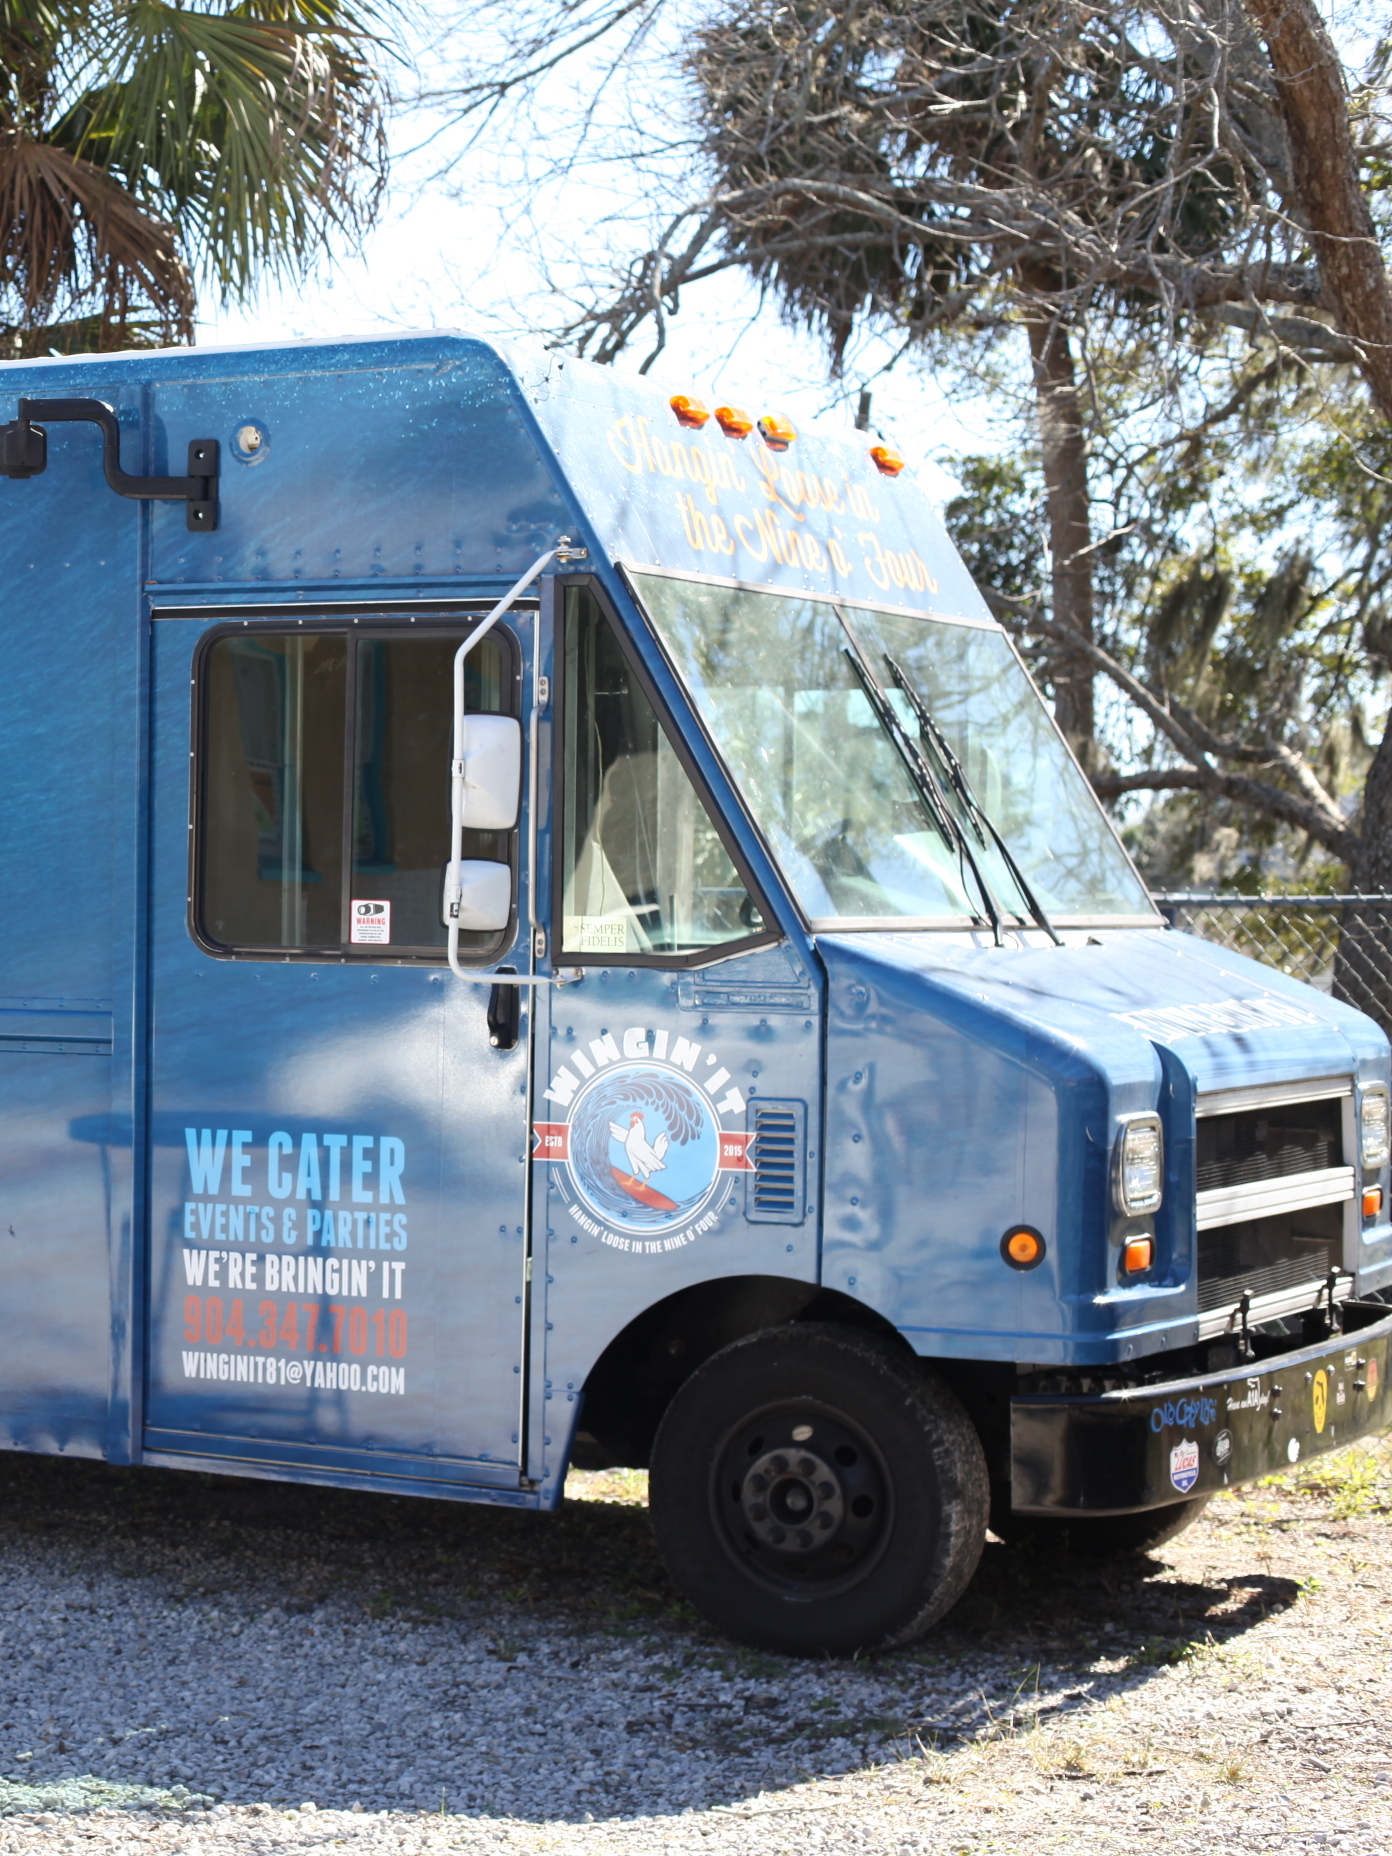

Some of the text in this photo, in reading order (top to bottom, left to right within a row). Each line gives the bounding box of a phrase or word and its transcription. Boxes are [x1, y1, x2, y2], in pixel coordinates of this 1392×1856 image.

[750, 444, 847, 522] Loose
[842, 469, 881, 523] in
[676, 491, 736, 556] the
[733, 507, 828, 573] Nine
[857, 531, 939, 595] Four
[356, 917, 385, 925] WARNING
[580, 923, 625, 934] SEMPER
[580, 936, 624, 947] FIDELIS
[544, 1135, 563, 1147] ESTD
[723, 1144, 742, 1157] 2015
[184, 1127, 406, 1205] WE CATER
[184, 1202, 407, 1251] EVENTS & PARTIES
[568, 1203, 604, 1238] HANGIN'
[601, 1230, 630, 1251] LOOSE
[631, 1240, 643, 1253] IN
[644, 1240, 663, 1254] THE
[664, 1232, 688, 1252] NINE
[694, 1210, 719, 1236] FOUR
[182, 1248, 406, 1300] WE'RE BRINGIN' IT
[184, 1294, 407, 1359] 904.347.7010
[181, 1350, 405, 1395] WINGINIT81@YAHOO.COM
[1174, 1455, 1197, 1471] LUCAS
